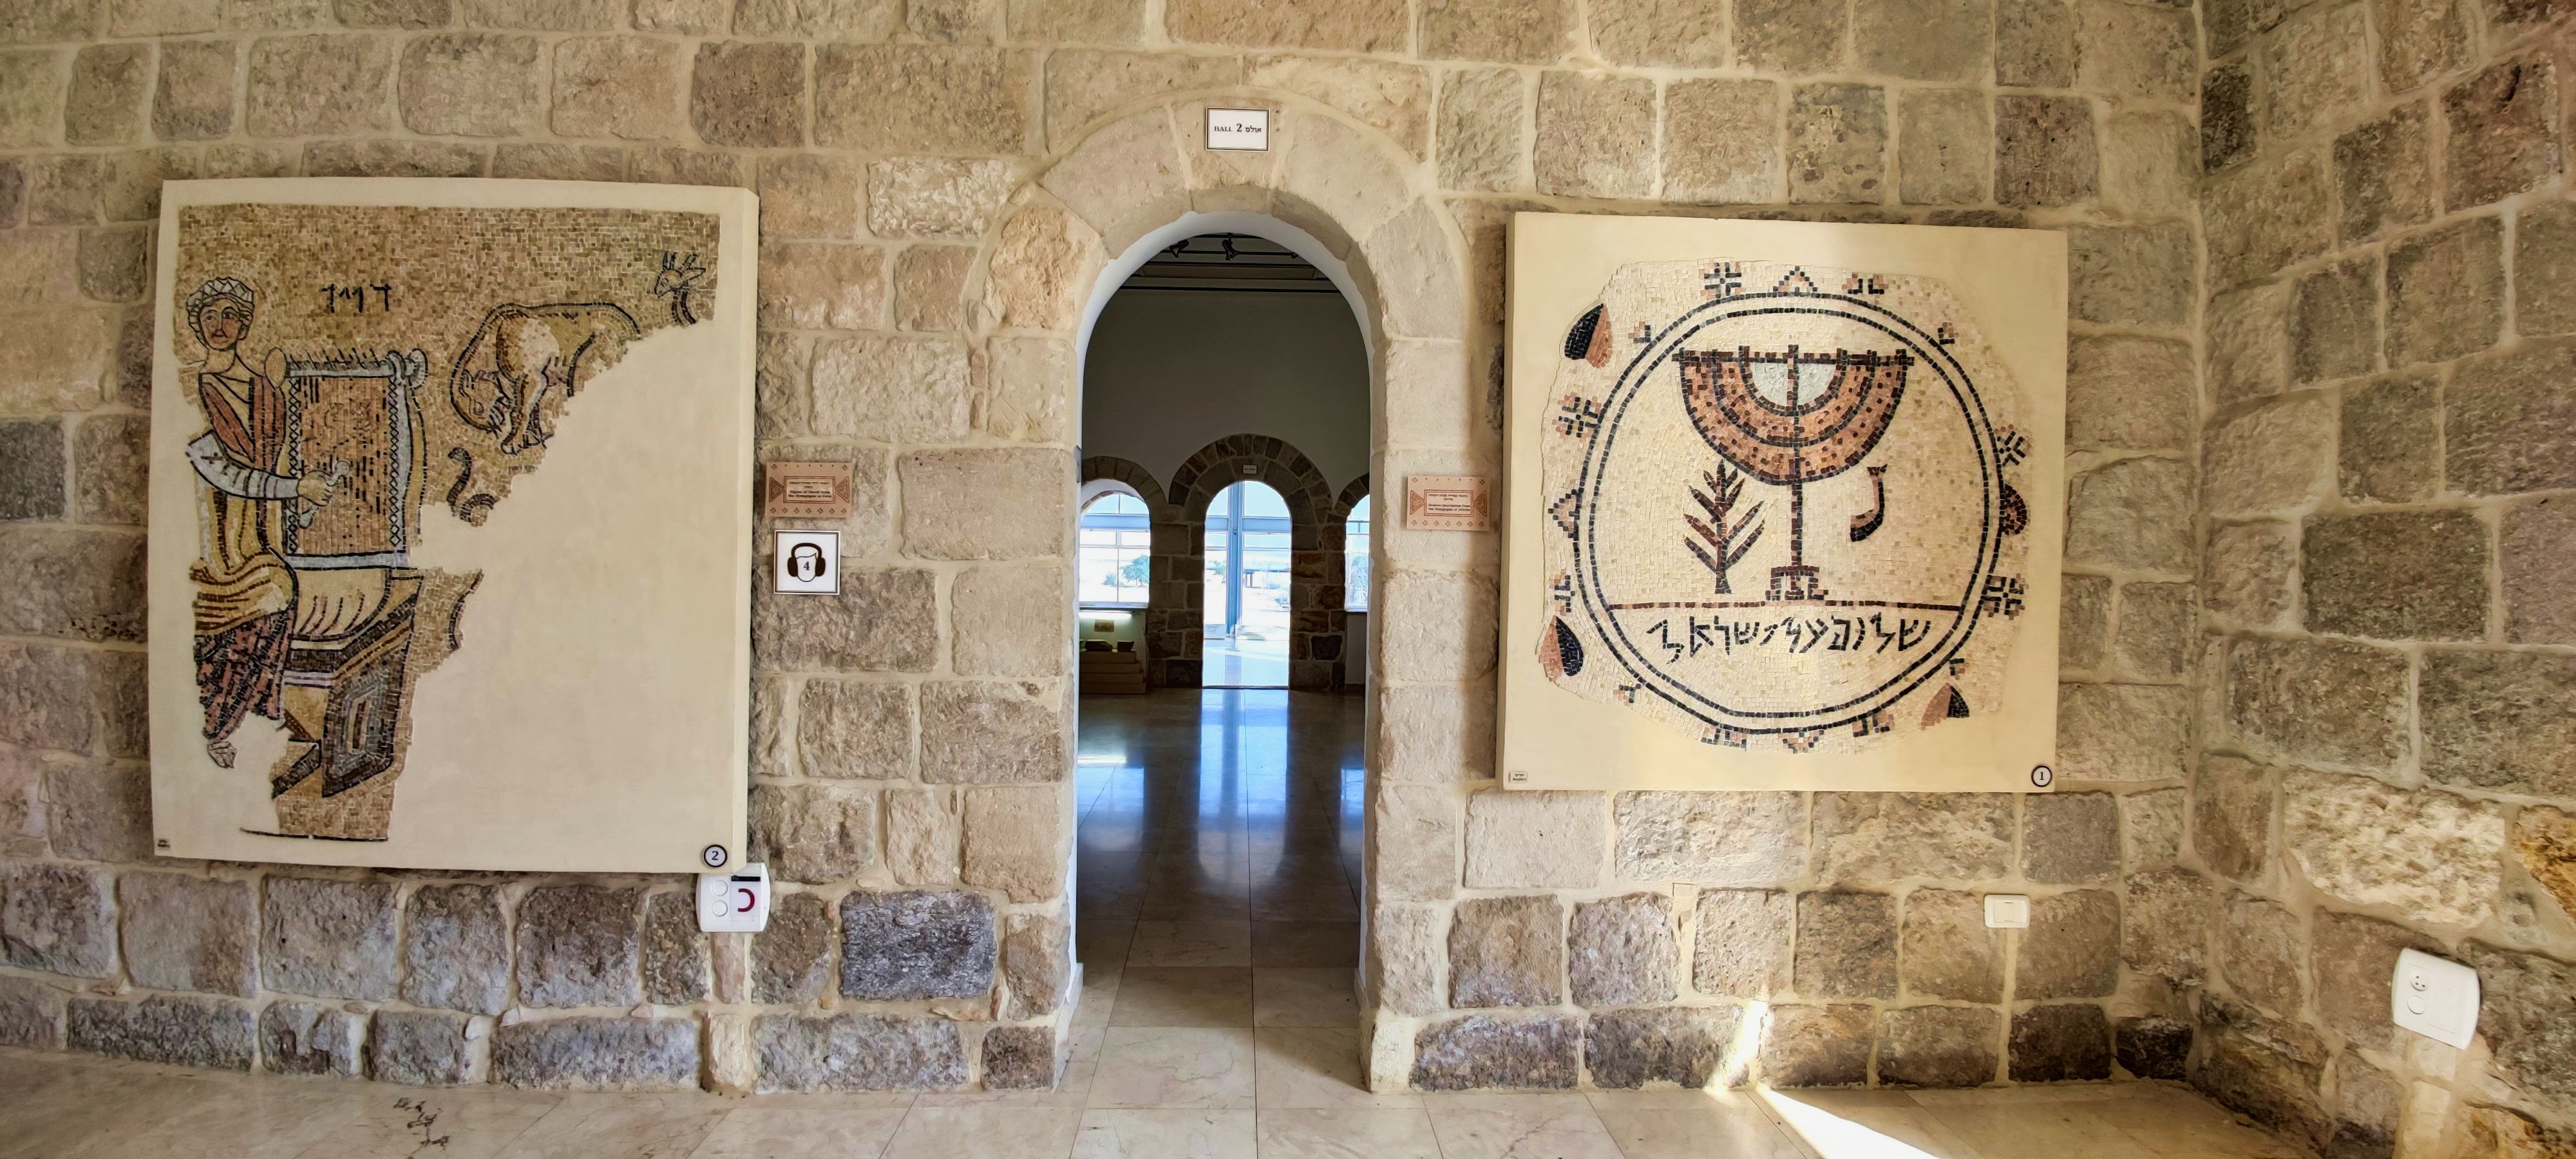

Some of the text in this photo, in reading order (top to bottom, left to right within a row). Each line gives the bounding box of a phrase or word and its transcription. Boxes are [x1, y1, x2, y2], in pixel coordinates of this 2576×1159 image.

[1236, 123, 1242, 132] 2
[803, 561, 810, 570] 4
[2040, 771, 2044, 780] 1
[711, 851, 719, 861] 2
